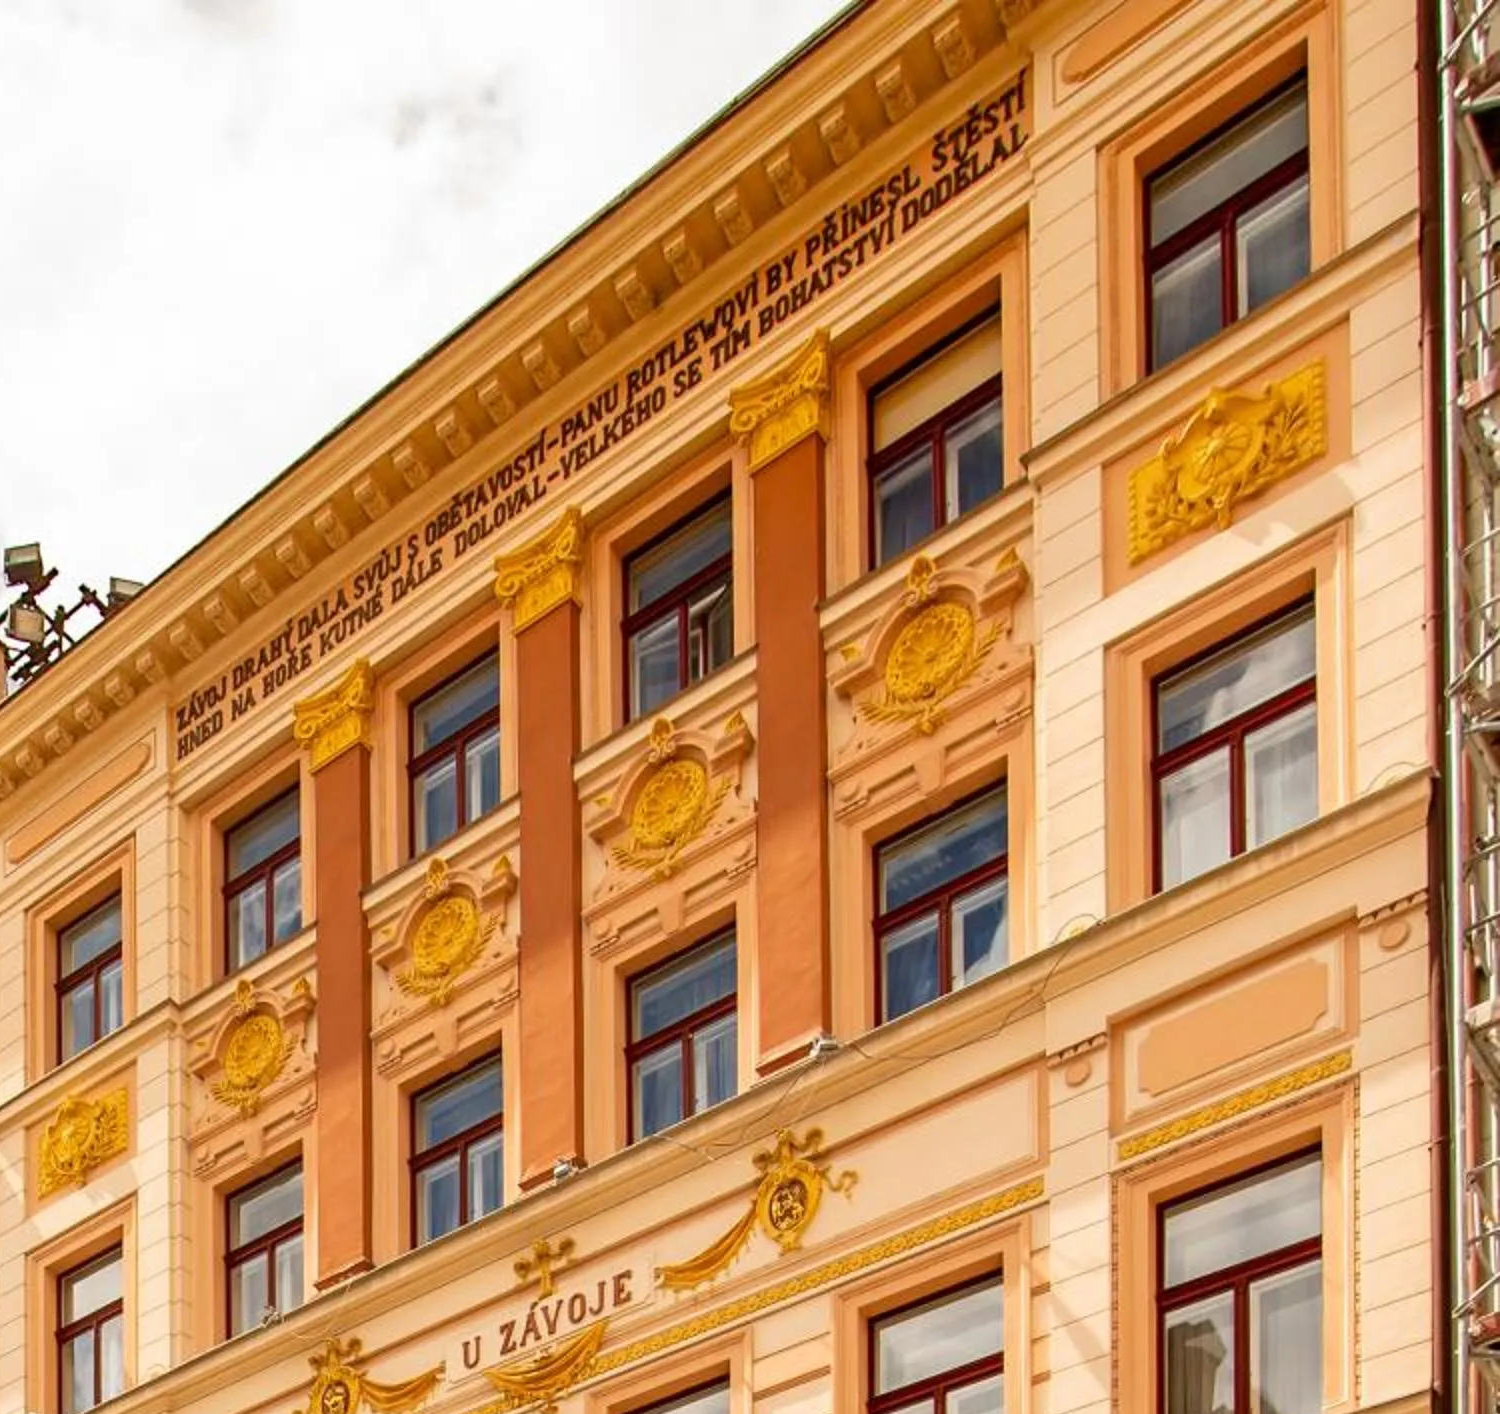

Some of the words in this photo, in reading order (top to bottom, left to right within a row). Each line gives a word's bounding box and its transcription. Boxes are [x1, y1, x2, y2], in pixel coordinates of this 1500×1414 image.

[176, 676, 228, 732] ZÁVOJ
[232, 618, 295, 691] DRAHÝ
[298, 588, 349, 641] DALA
[353, 543, 402, 600] SVŮJ
[407, 534, 419, 557] S
[766, 250, 798, 297] BY
[805, 165, 921, 269] PŘÍNESL
[932, 67, 1027, 172] ŠTĚSTÍ
[177, 710, 223, 760] HNED
[231, 687, 257, 721] NA
[262, 643, 312, 698] HOŘE
[319, 583, 384, 657] KUTNÉ
[391, 548, 443, 604] DÁLE
[673, 356, 702, 399] SE
[710, 320, 750, 371] TÍM
[758, 201, 898, 338] BOHATSTVÍ
[461, 1335, 482, 1370] U
[499, 1269, 633, 1357] ZÁVOJE
